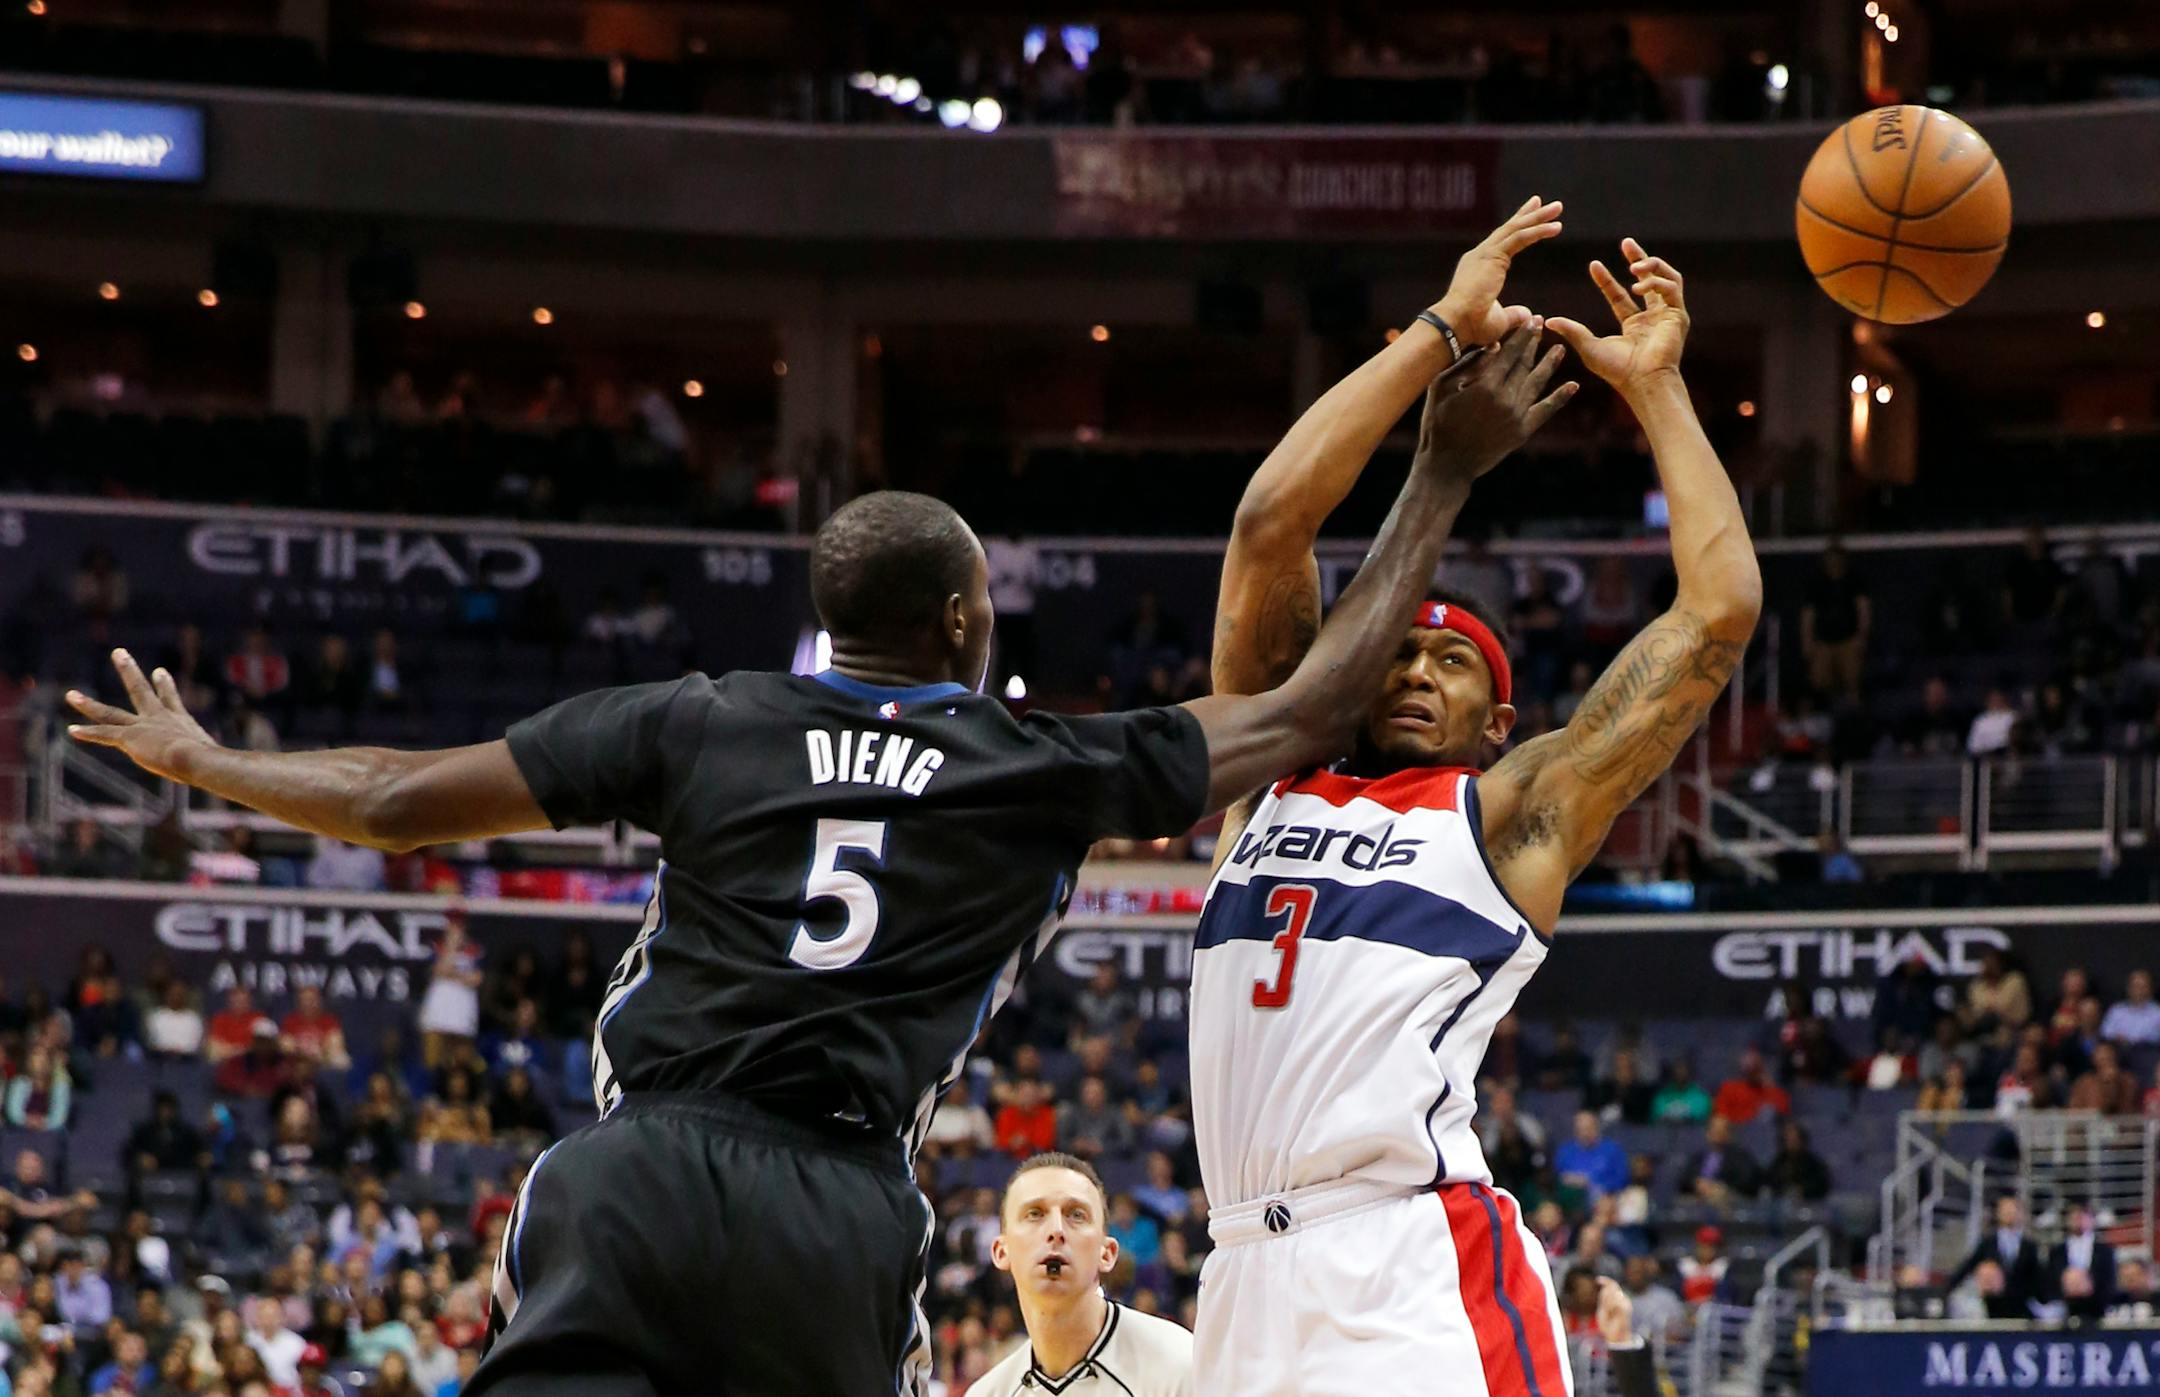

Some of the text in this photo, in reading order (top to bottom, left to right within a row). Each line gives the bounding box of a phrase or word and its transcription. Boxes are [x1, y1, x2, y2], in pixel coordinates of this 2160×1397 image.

[187, 523, 543, 590] ETIHAD
[806, 729, 945, 797] DIENG
[789, 817, 887, 971] 5
[210, 959, 411, 1002] AIRWAYS
[1252, 883, 1319, 1011] 3
[1712, 928, 2013, 981] ETIHAD
[1921, 1340, 2160, 1388] MASERA
